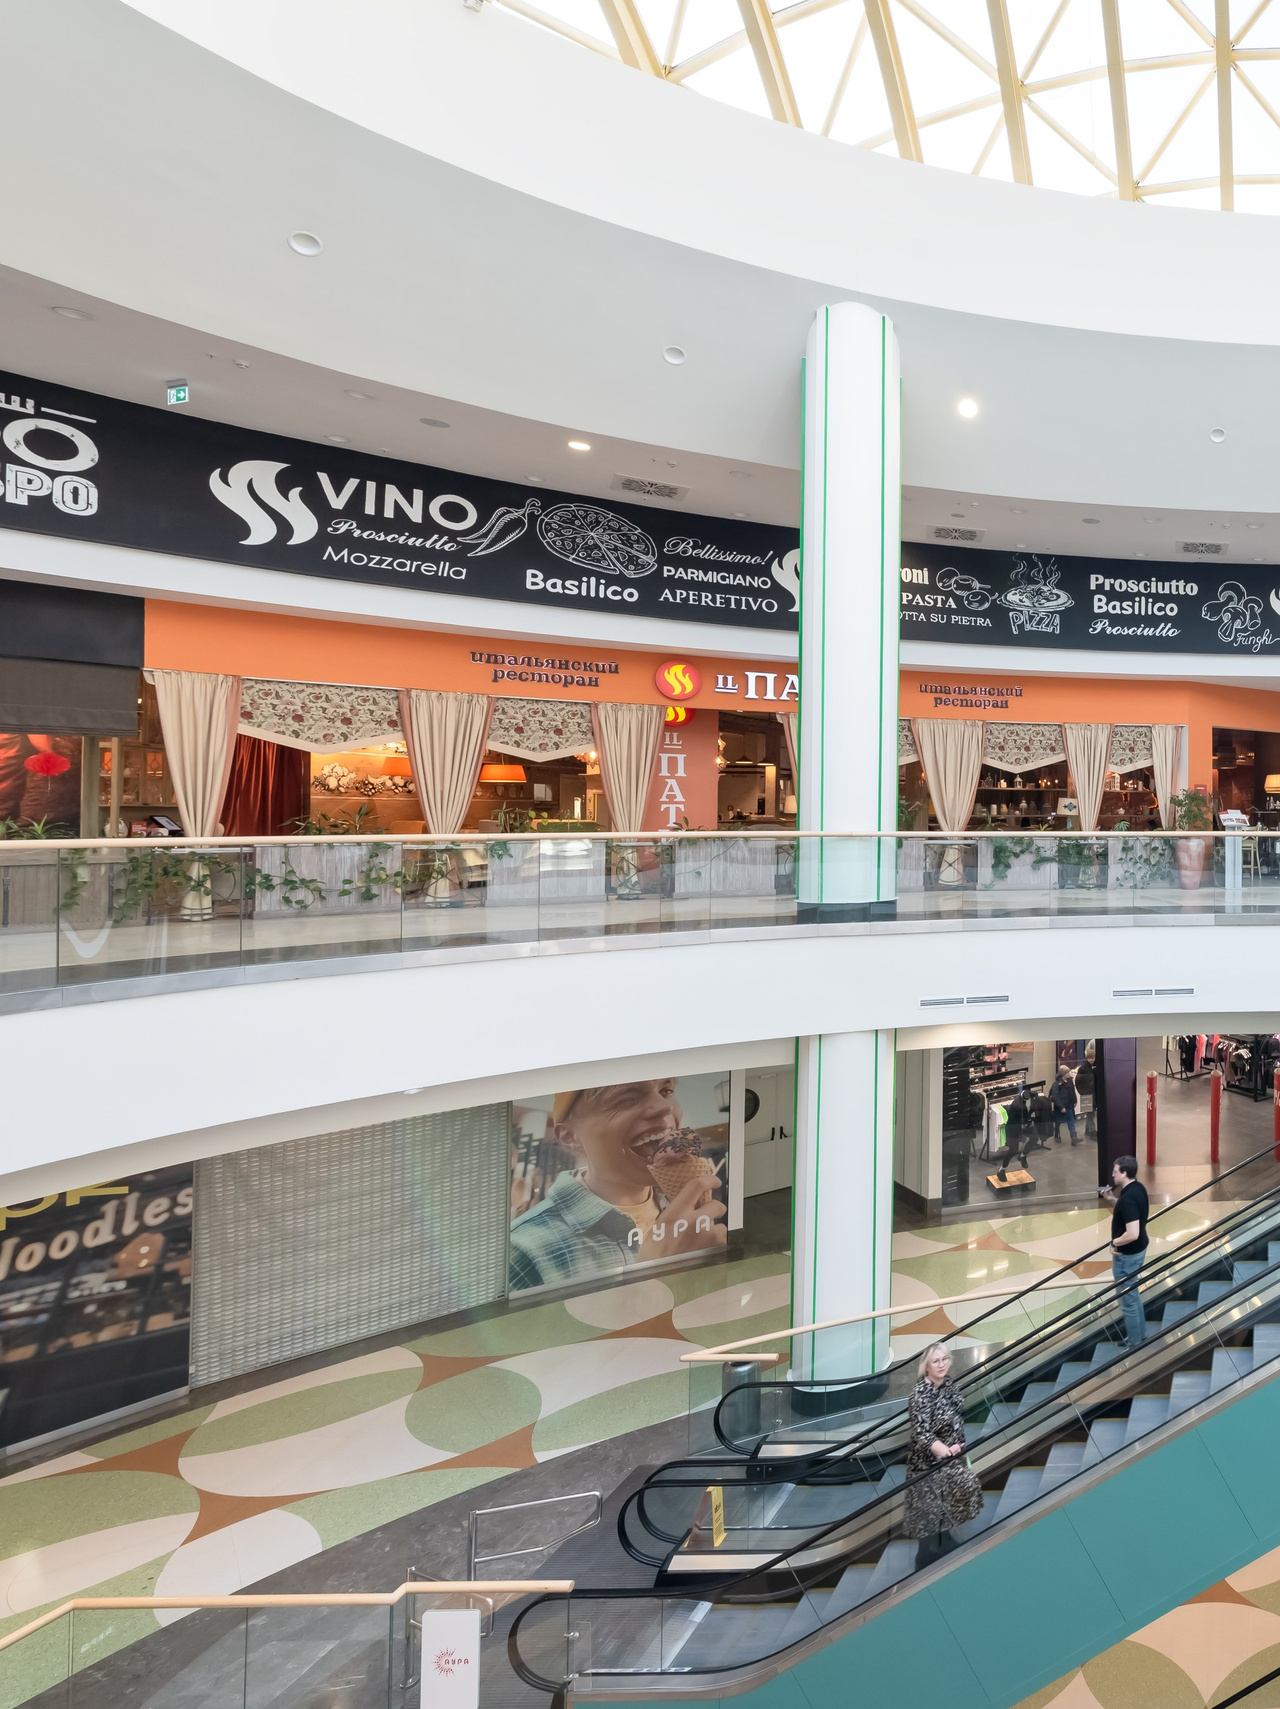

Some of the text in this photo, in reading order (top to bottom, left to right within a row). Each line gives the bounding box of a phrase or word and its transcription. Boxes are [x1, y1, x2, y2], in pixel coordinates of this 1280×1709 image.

[316, 471, 478, 531] VINO
[327, 518, 463, 552] Prosciutto
[322, 545, 467, 580] Mozzarella
[663, 536, 773, 566] Bellissimo!
[525, 569, 639, 602] Basilico
[663, 565, 772, 589] PARMIGIANO
[900, 567, 929, 585] oni
[1089, 573, 1198, 596] Prosciutto
[658, 588, 778, 613] APERETIVO
[901, 592, 957, 609] PASTA
[1093, 594, 1178, 616] Basilico
[900, 611, 992, 627] TTA SU PIETRA
[1009, 610, 1061, 635] PIZZA
[1089, 618, 1181, 637] Prosciutto
[1233, 630, 1280, 653] Funghi
[470, 650, 620, 675] итальянский
[492, 666, 600, 689] ресторан
[918, 683, 1023, 699] итальянский
[933, 696, 1010, 710] ресторан
[658, 753, 687, 832] ПАТ
